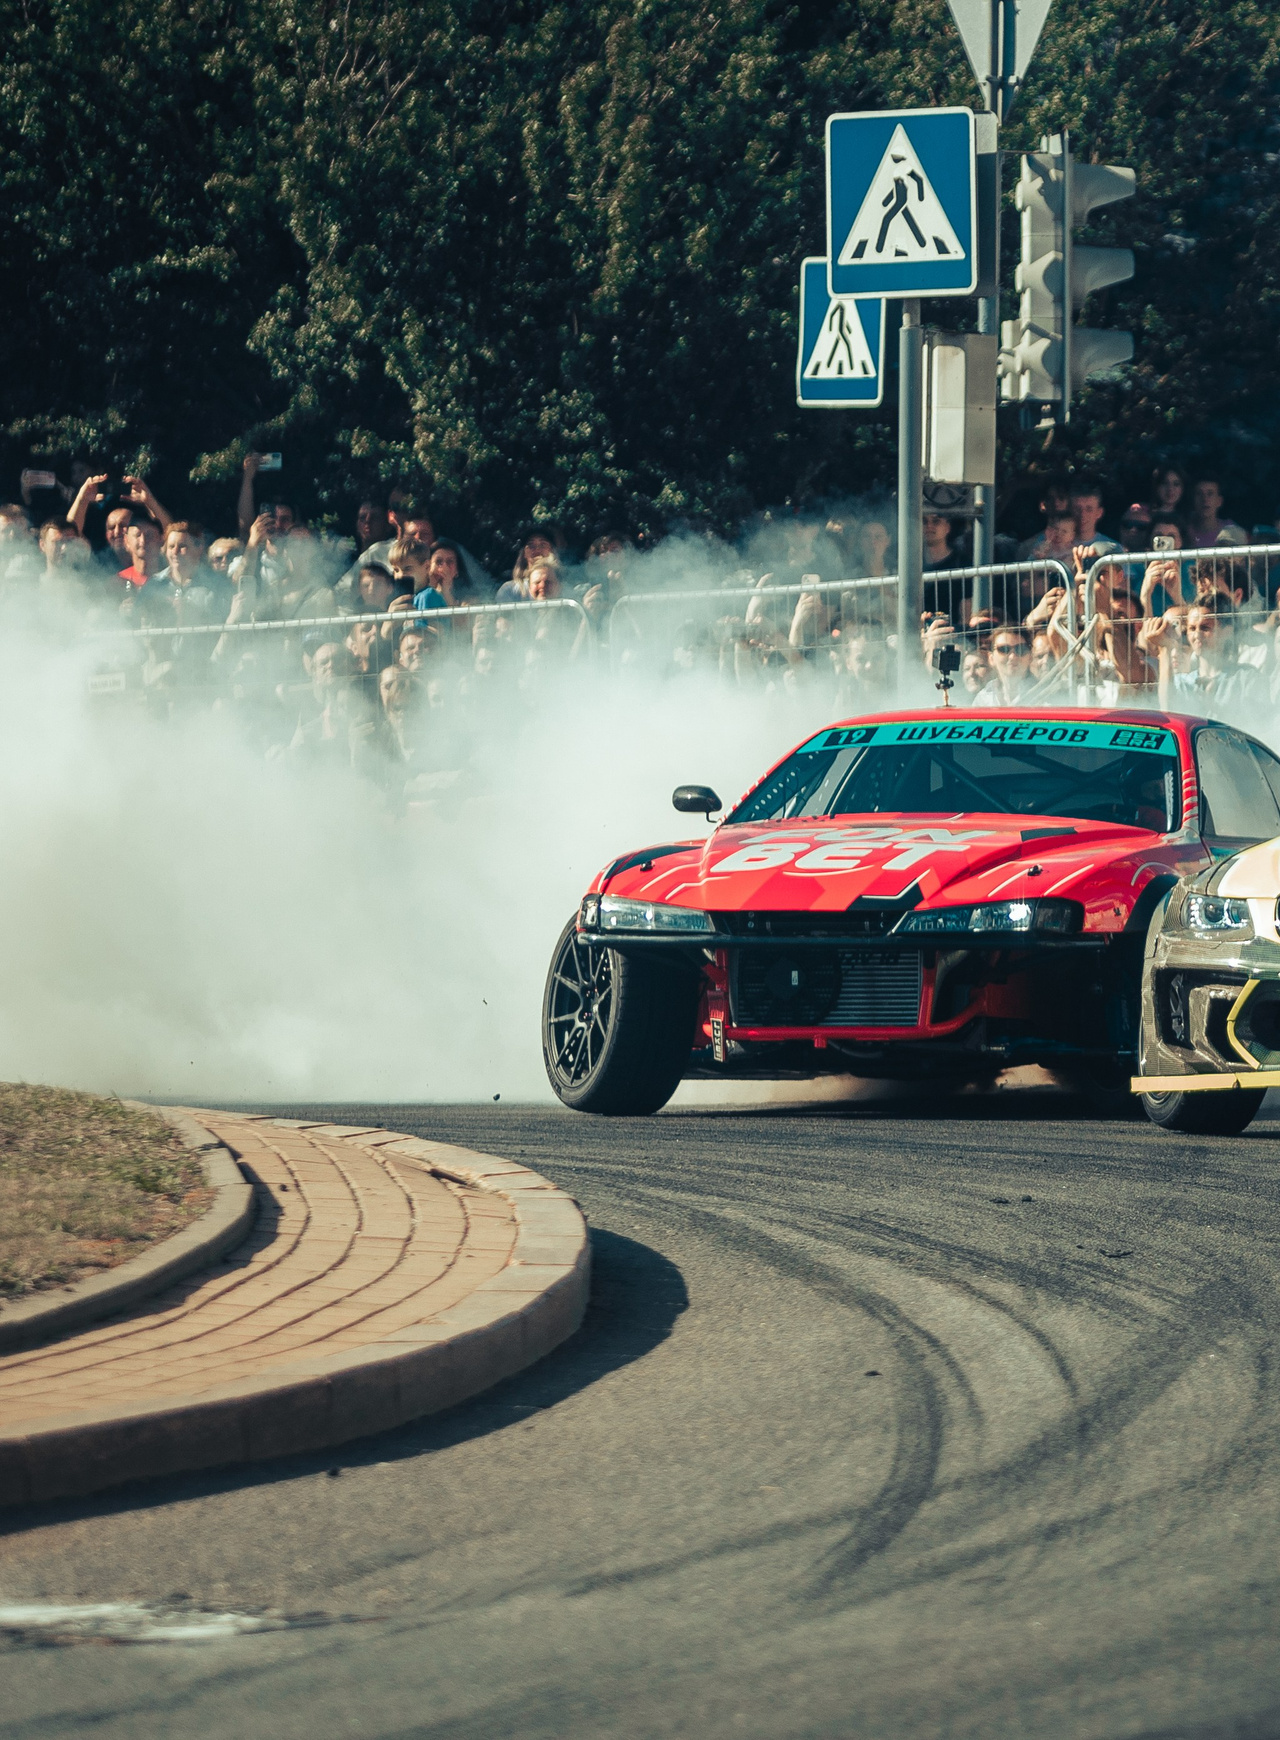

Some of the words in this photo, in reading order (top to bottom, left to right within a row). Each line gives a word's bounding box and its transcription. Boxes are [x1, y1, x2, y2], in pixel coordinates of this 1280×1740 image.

[837, 729, 867, 745] 19
[896, 723, 1090, 743] ШУБАДЁРОВ
[738, 828, 996, 844] FON
[710, 842, 970, 872] BET
